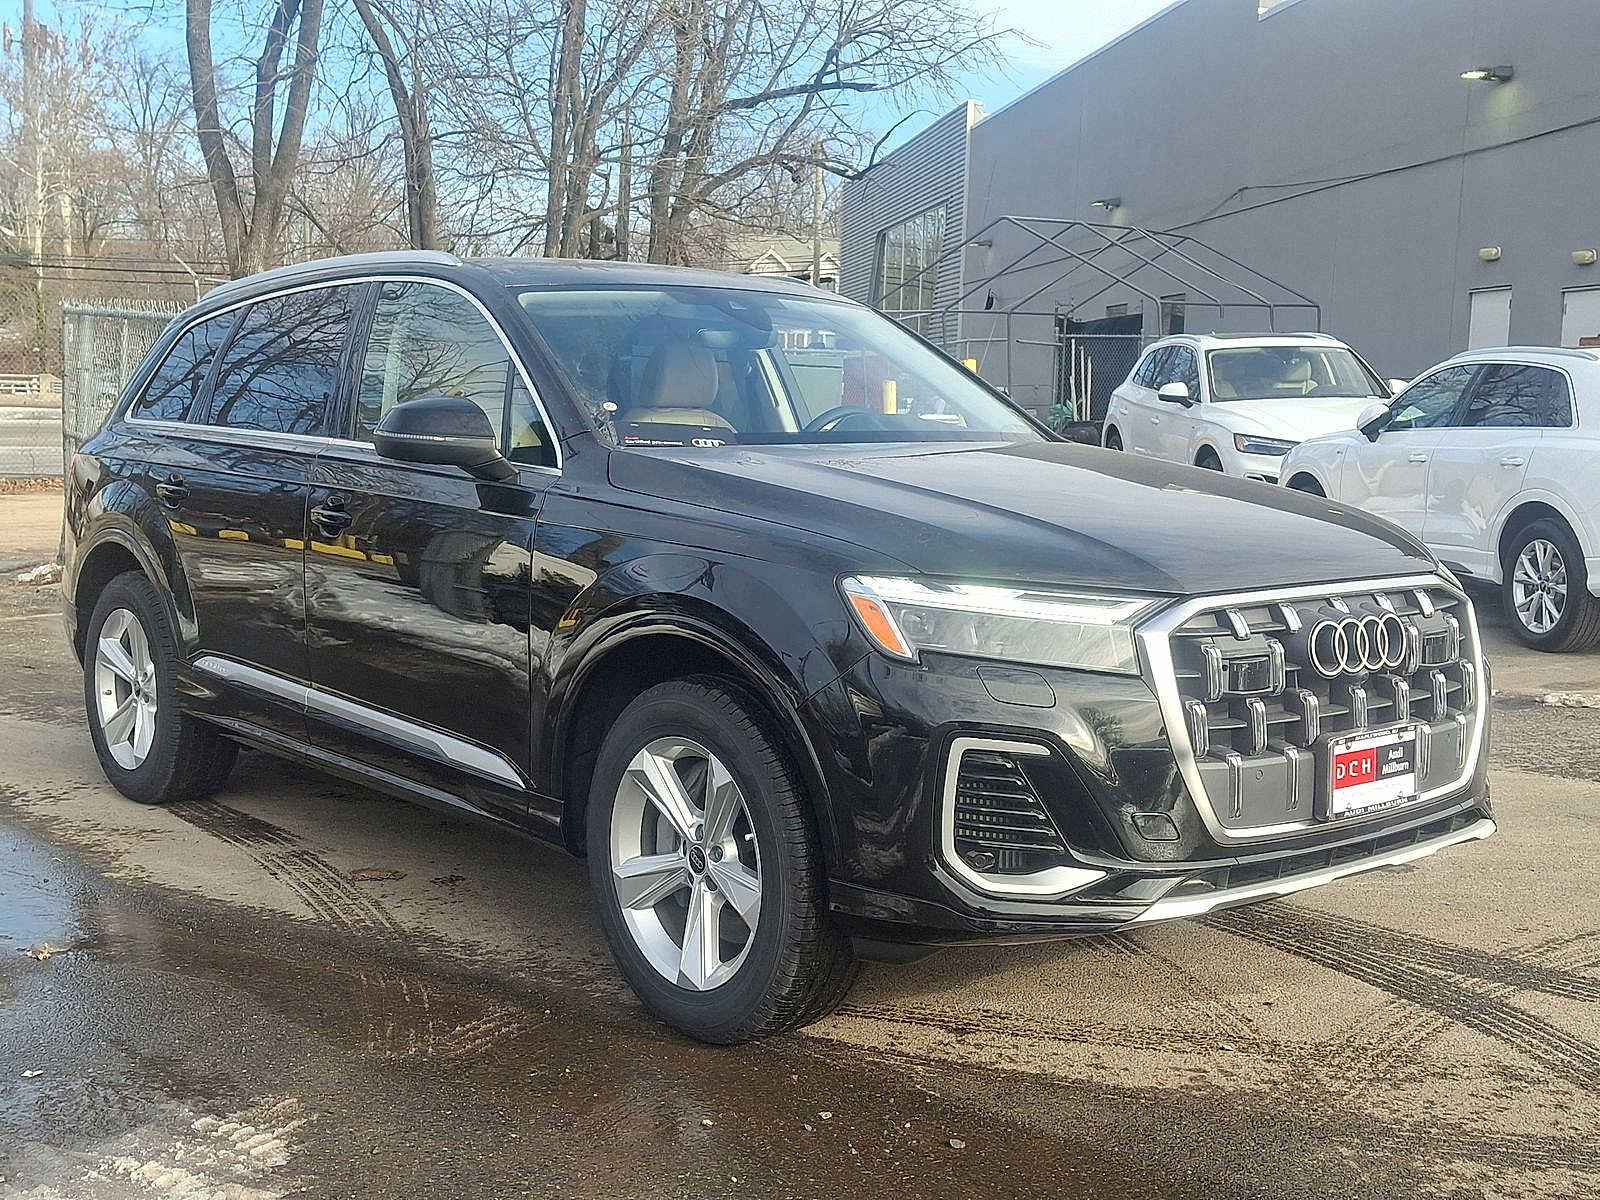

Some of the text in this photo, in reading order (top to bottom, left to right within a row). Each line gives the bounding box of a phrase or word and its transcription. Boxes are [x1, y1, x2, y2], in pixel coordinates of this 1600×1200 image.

[1388, 746, 1404, 760] Audi
[1381, 761, 1410, 775] Millburn
[1343, 796, 1409, 818] AUDI MILLBURN
